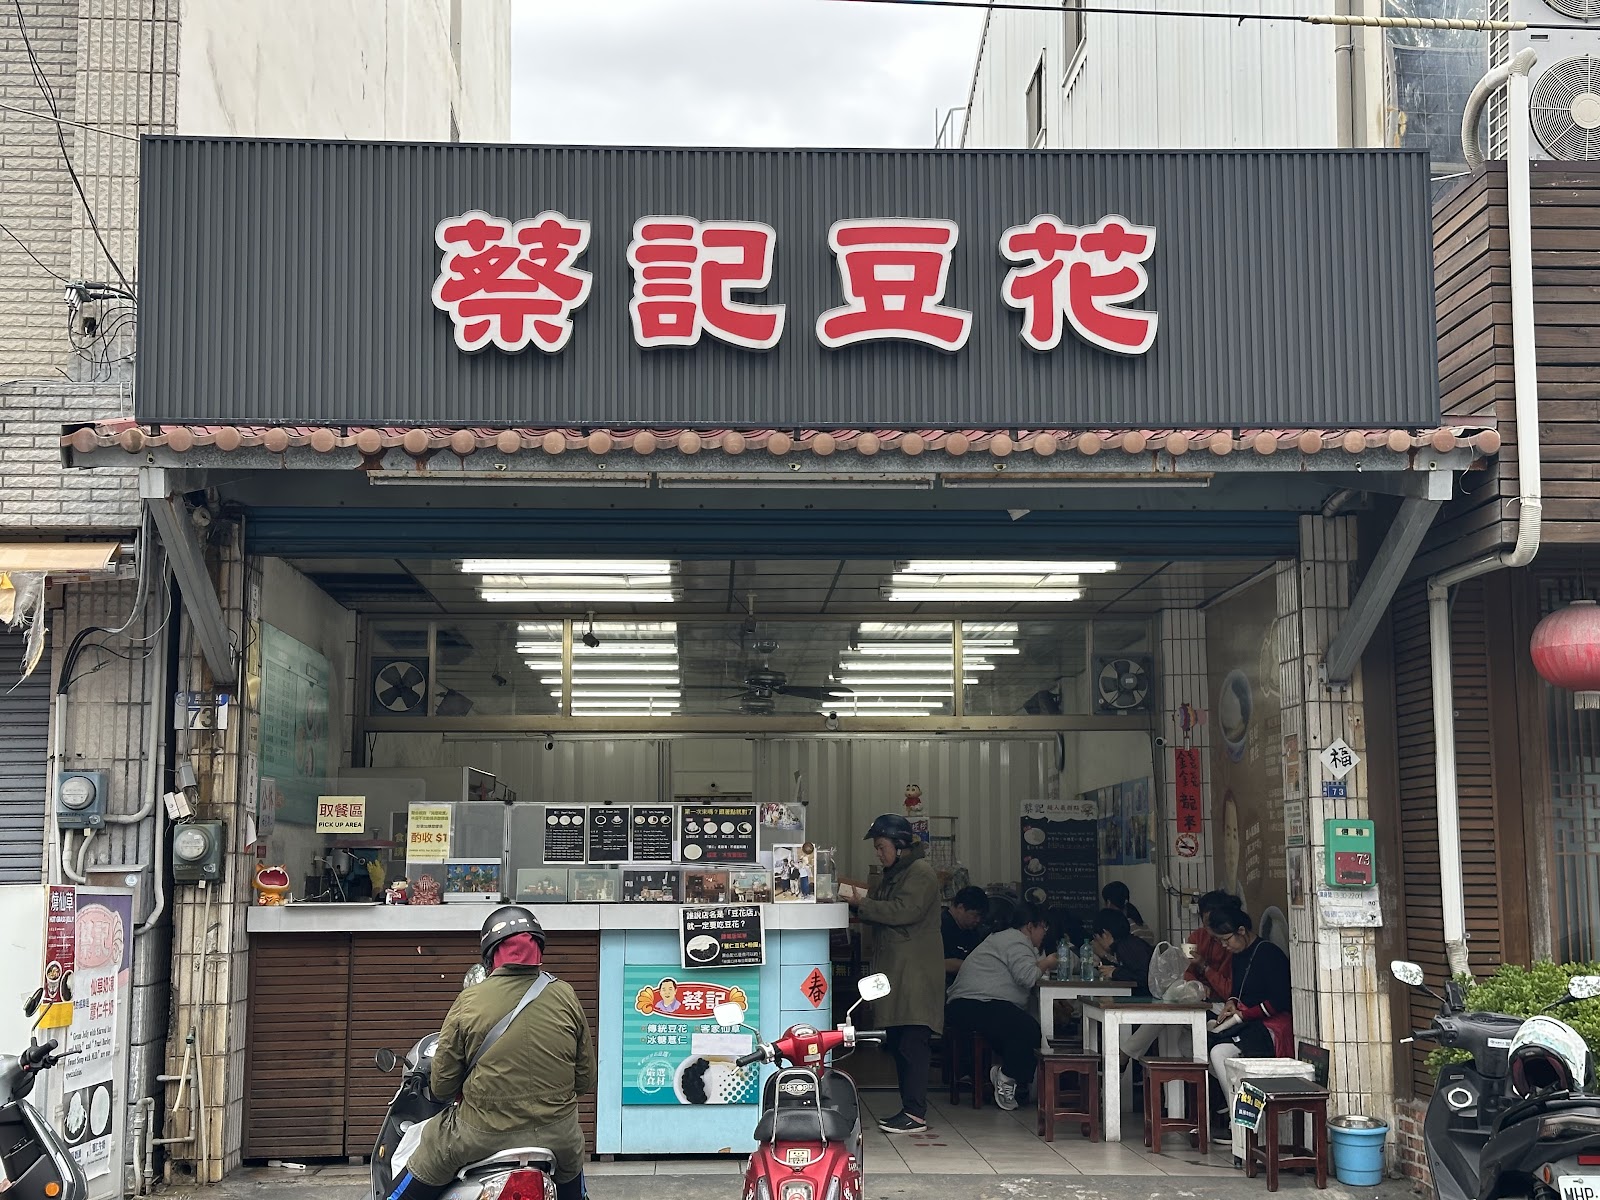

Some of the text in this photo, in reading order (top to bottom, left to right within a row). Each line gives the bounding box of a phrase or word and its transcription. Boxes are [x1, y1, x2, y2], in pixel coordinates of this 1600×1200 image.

[434, 211, 1159, 356] 蔡記豆花
[188, 707, 213, 728] 73
[1330, 746, 1353, 769] 福
[1332, 788, 1345, 796] 73
[319, 803, 363, 818] 取餐區
[411, 832, 447, 843] 酌收 $1
[1341, 828, 1364, 836] 信箱
[1356, 853, 1370, 866] 73
[51, 891, 74, 912] 燒仙草
[808, 972, 825, 1002] 春
[682, 991, 727, 1011] 蔡記
[646, 1023, 688, 1034] 傳統豆花
[646, 1035, 688, 1045] 冰糖薏仁
[786, 1083, 808, 1092] STOP
